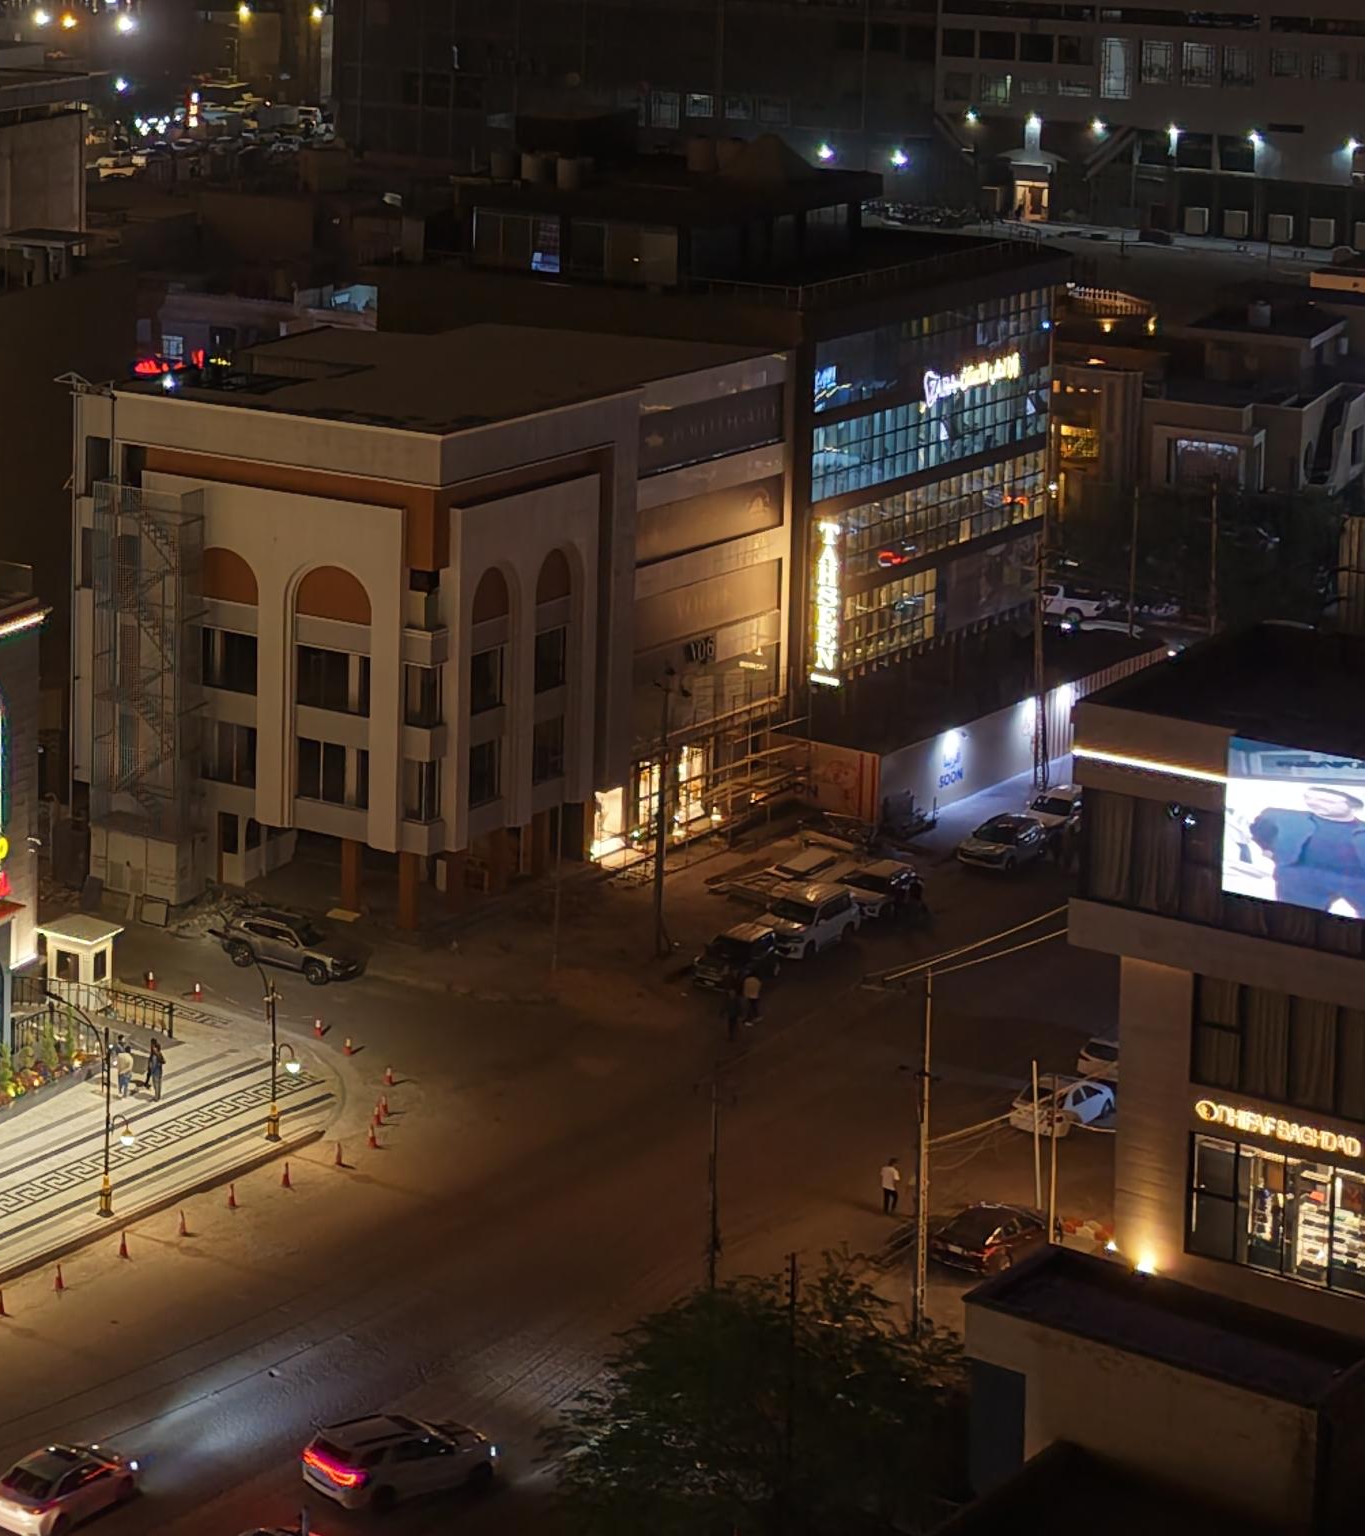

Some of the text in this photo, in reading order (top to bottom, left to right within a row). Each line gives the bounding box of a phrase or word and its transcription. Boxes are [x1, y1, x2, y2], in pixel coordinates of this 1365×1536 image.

[815, 522, 840, 671] TAHSEEN
[938, 767, 964, 789] SOON
[1275, 1119, 1362, 1157] BAGHDAD
